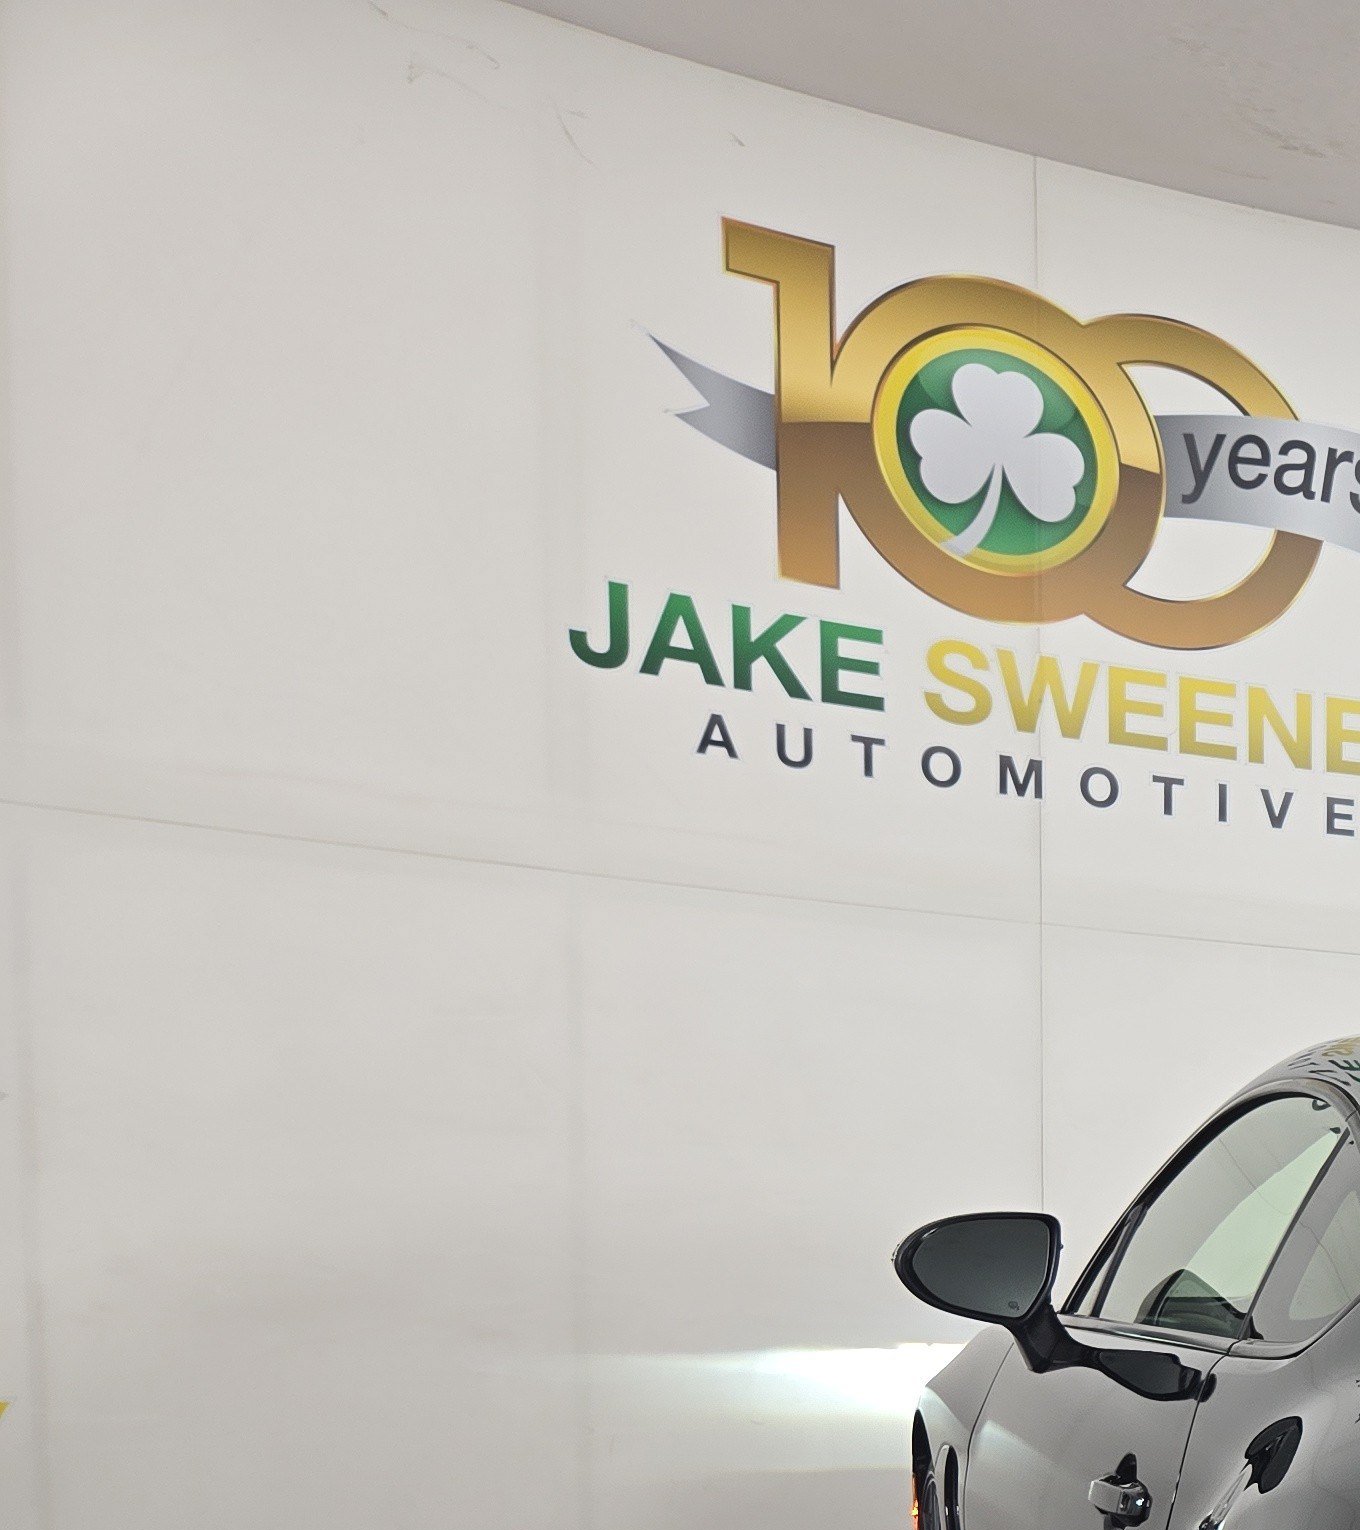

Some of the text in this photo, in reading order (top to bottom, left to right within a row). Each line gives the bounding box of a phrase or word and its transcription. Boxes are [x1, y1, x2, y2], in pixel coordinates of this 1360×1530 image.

[721, 215, 1323, 651] 100
[568, 581, 887, 712] JAKE
[695, 713, 1357, 838] AUTOMOTIVE
